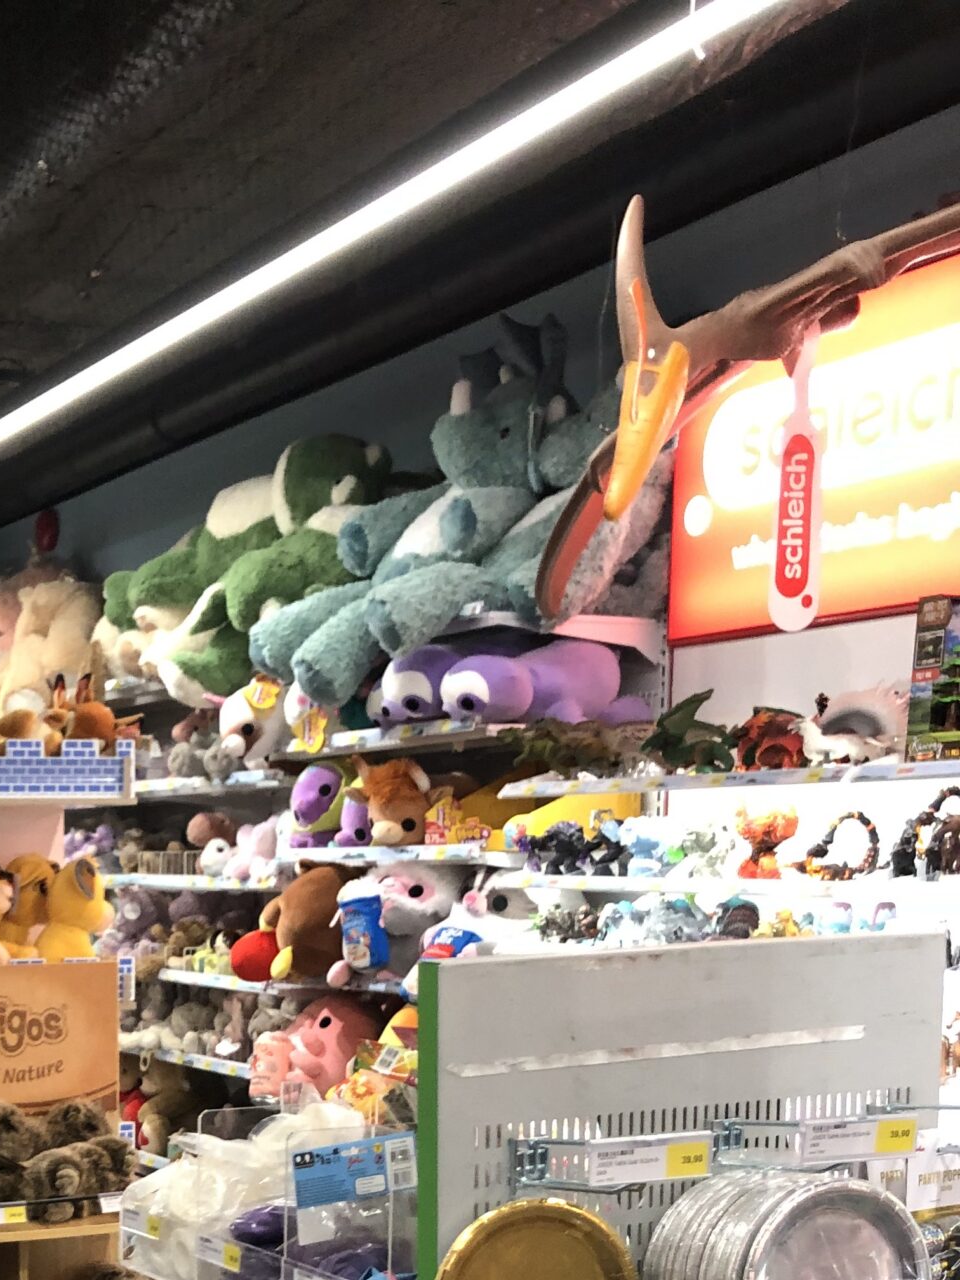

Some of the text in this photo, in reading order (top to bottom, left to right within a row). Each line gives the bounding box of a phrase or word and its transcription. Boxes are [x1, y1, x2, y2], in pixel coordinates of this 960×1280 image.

[782, 452, 809, 580] schleich
[3, 1059, 64, 1083] Nature
[890, 1129, 910, 1138] 39.90
